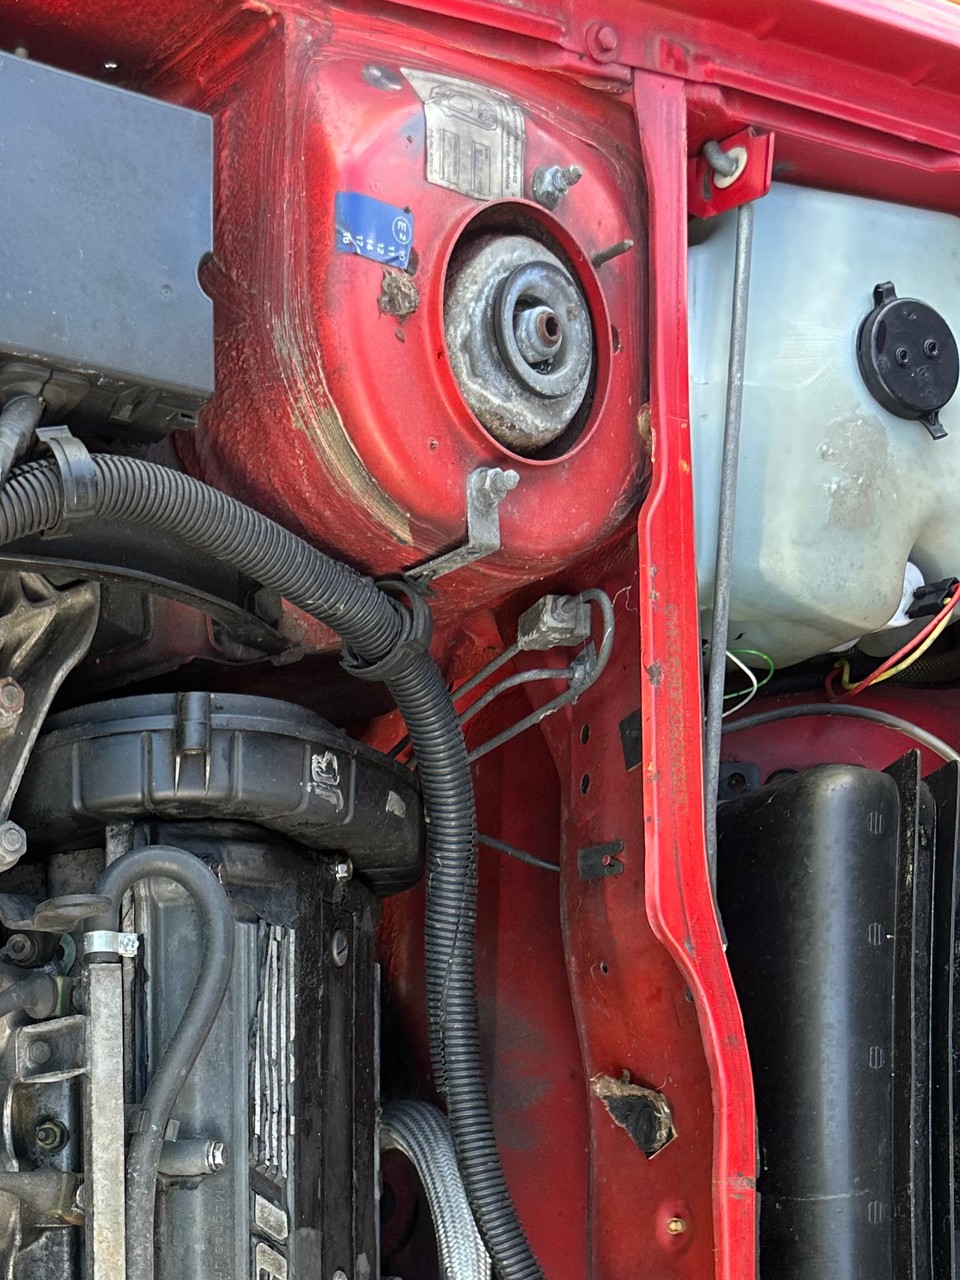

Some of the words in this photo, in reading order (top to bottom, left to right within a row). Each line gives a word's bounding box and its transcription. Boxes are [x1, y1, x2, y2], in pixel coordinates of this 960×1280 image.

[343, 232, 352, 244] 18
[356, 236, 363, 247] 17
[366, 239, 373, 251] 14
[377, 243, 384, 254] 12
[388, 246, 395, 256] 11
[399, 250, 405, 261] 10
